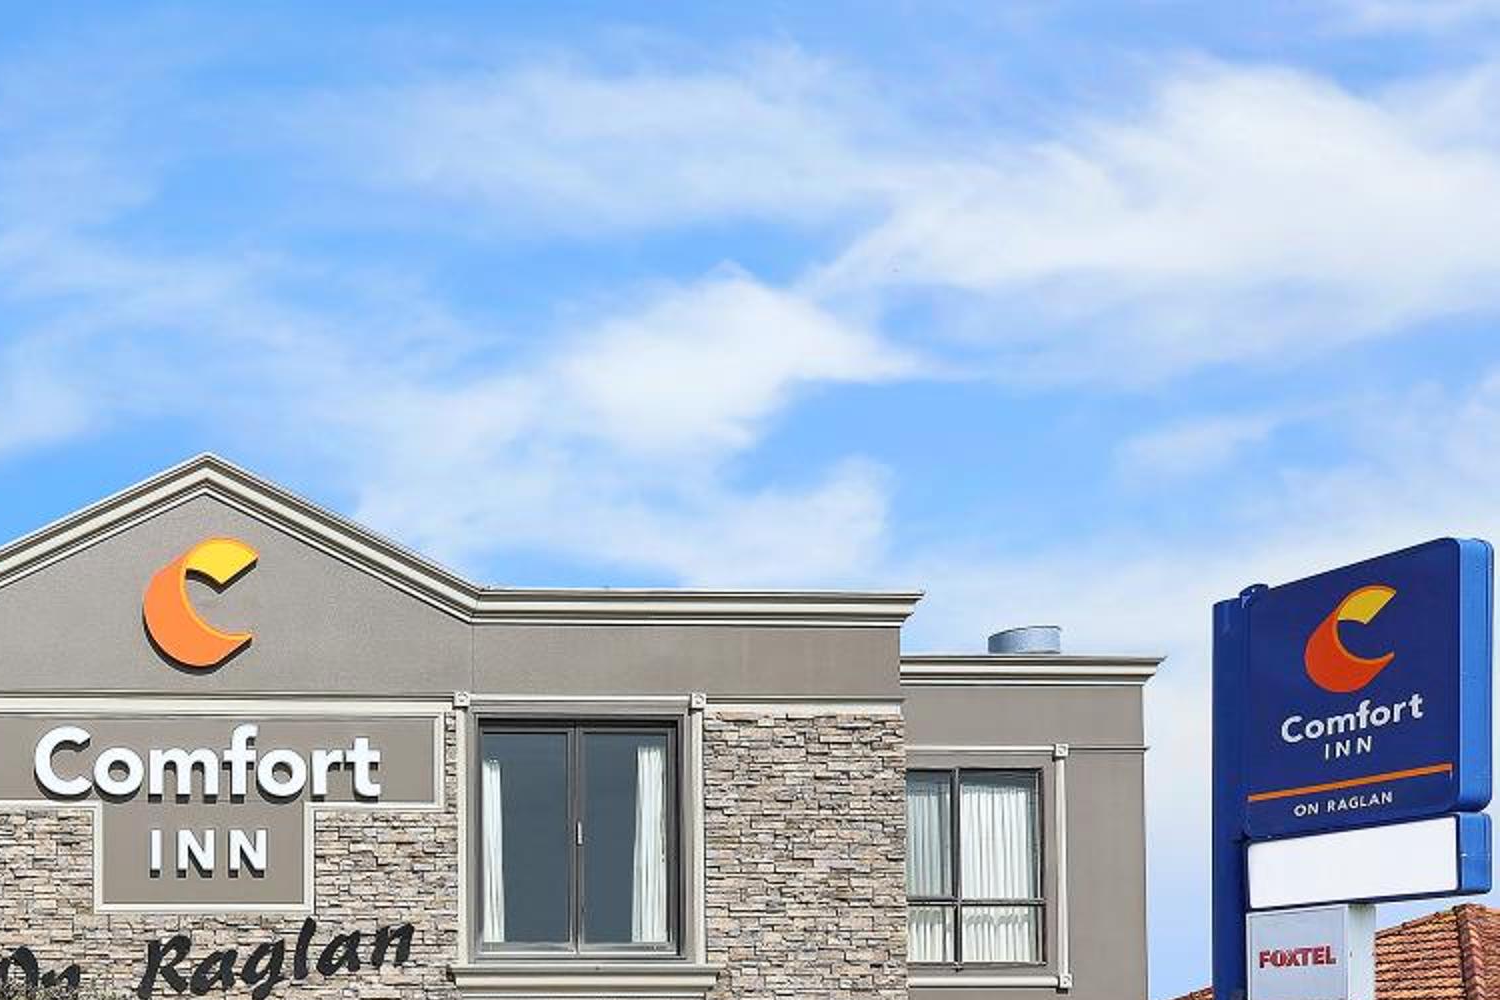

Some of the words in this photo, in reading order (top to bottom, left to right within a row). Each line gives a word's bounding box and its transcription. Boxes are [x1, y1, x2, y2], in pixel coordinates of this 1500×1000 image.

[1280, 693, 1424, 743] Comfort
[33, 723, 383, 800] Comfort
[1324, 735, 1373, 760] INN
[1293, 802, 1319, 817] ON
[1326, 791, 1393, 813] RAGLAN
[149, 828, 268, 877] INN
[136, 916, 415, 1000] Raglan
[1259, 946, 1336, 968] FOXTEL
